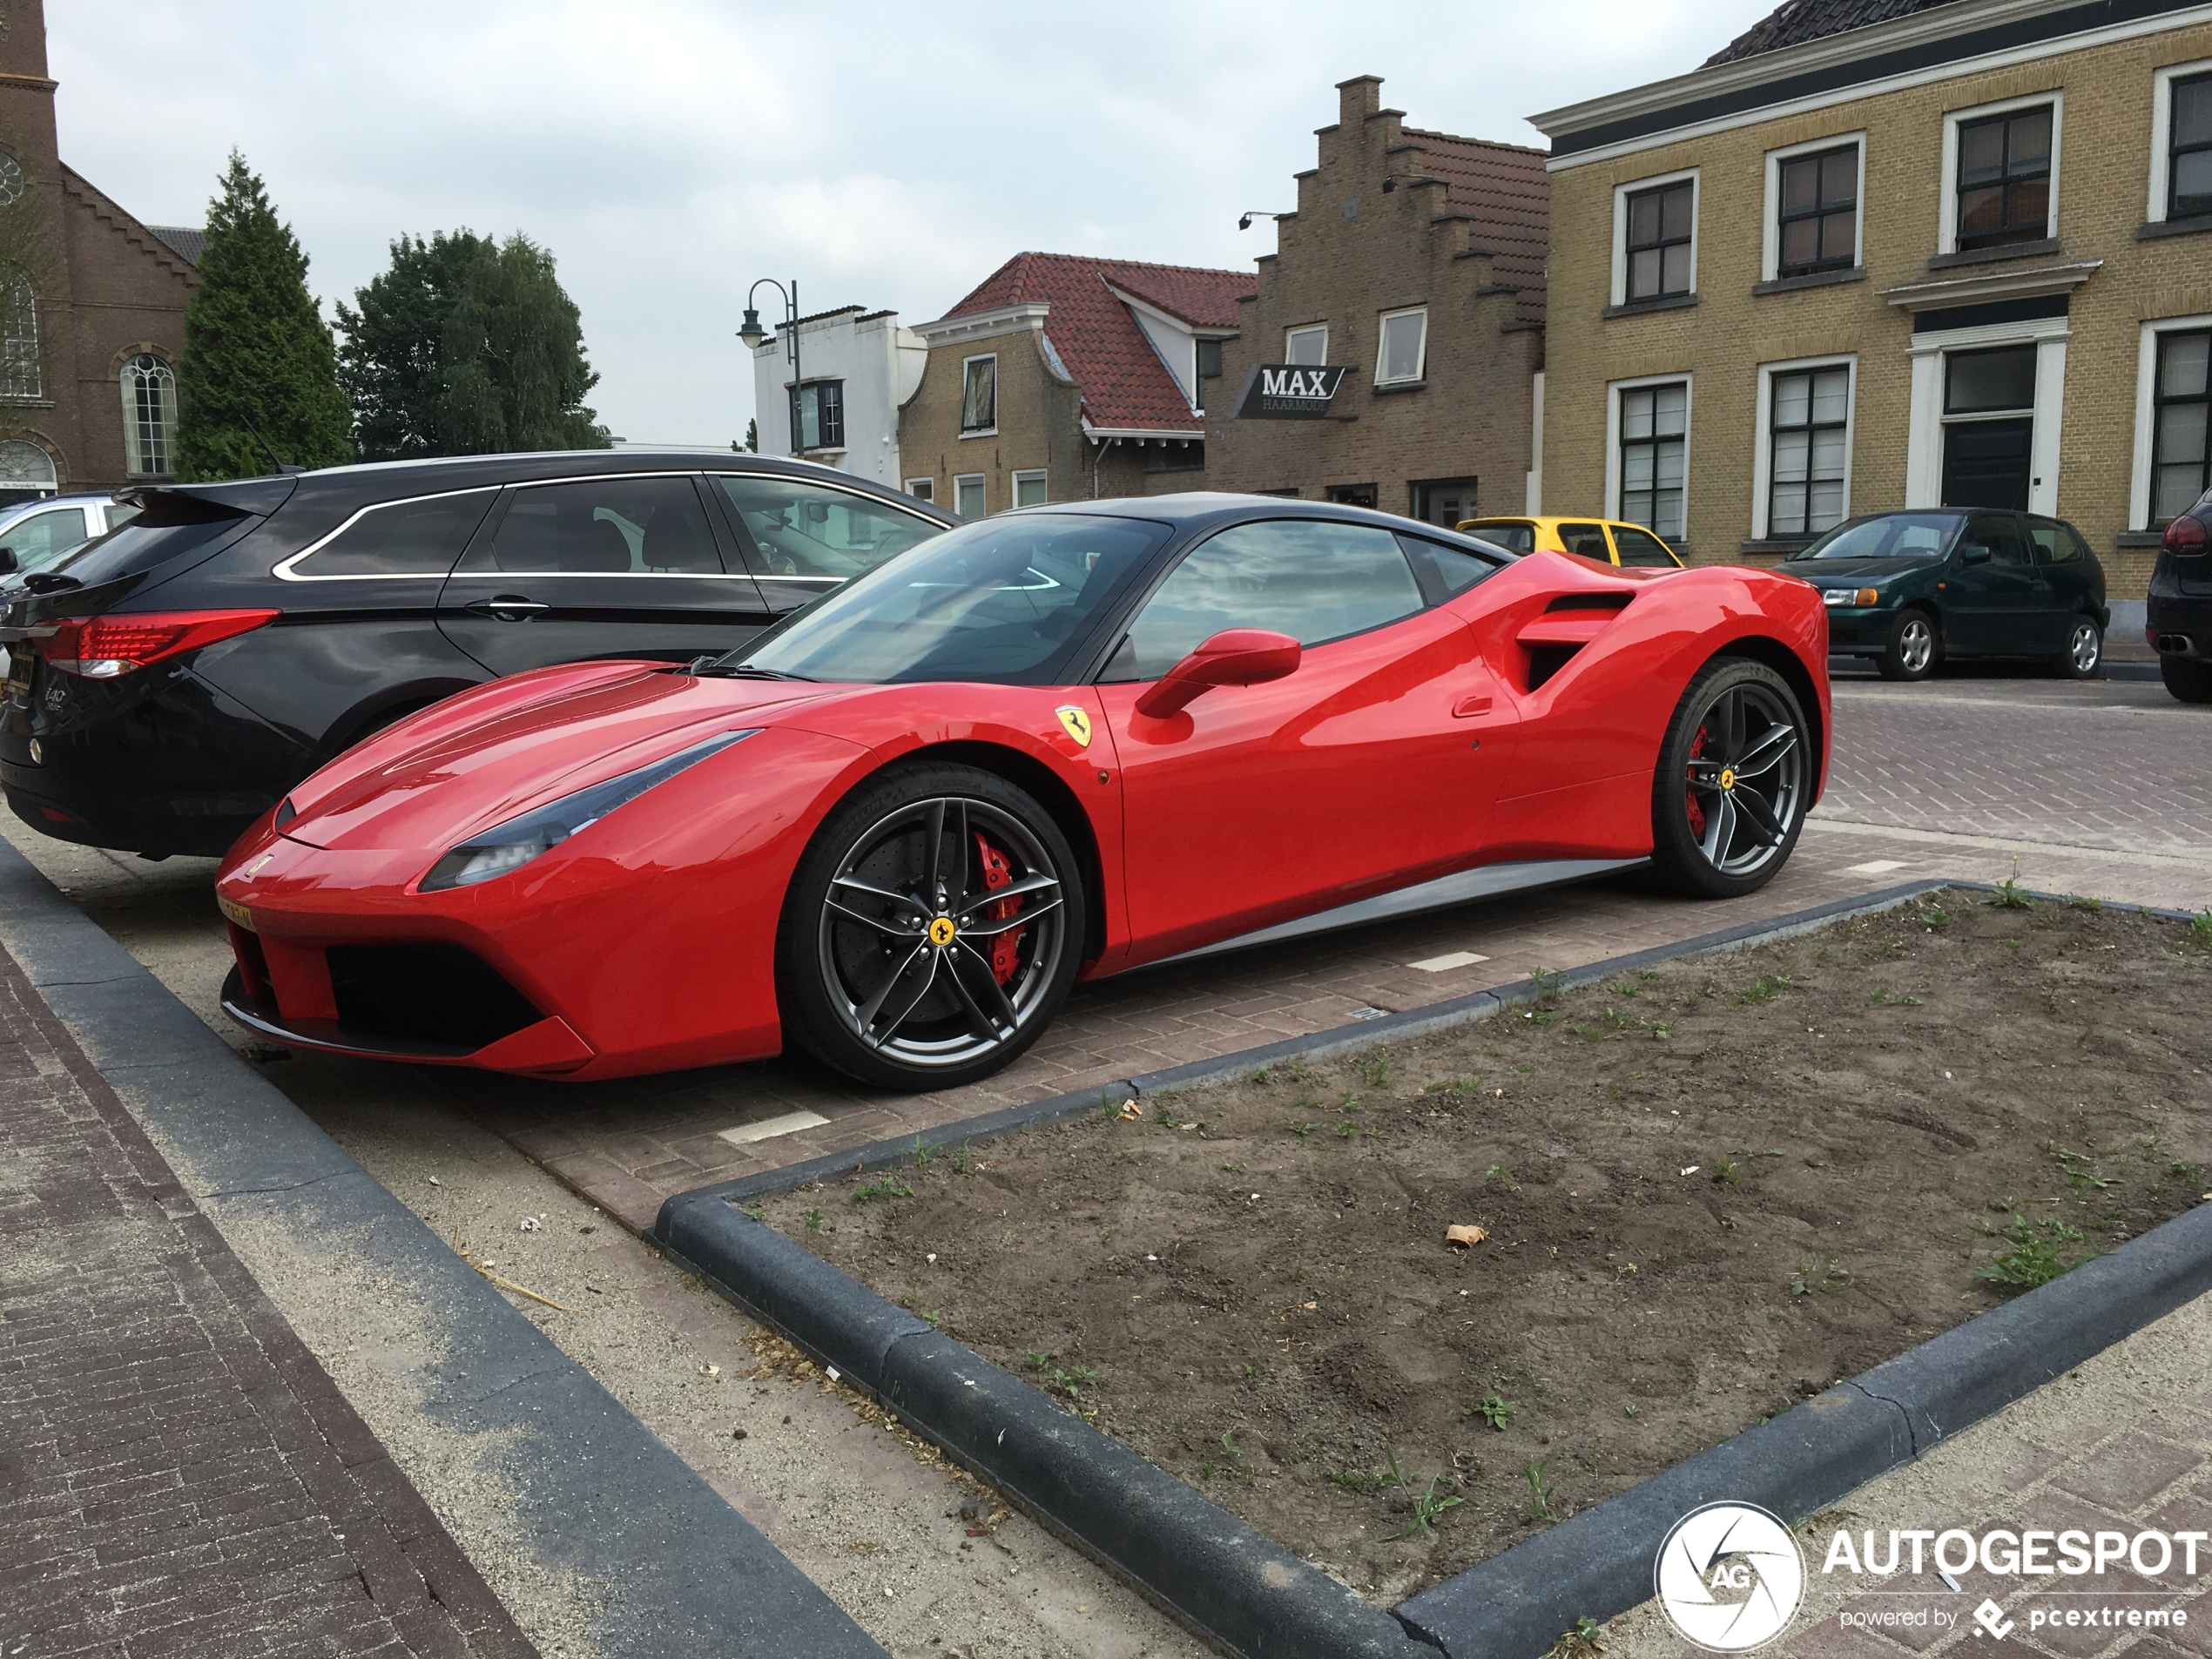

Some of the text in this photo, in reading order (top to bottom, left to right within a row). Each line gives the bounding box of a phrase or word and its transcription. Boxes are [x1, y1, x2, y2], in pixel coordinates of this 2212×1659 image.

[1262, 368, 1327, 396] MAX
[1263, 398, 1327, 412] HAARMODE
[44, 687, 65, 702] i40
[828, 797, 883, 851] MICHELIN
